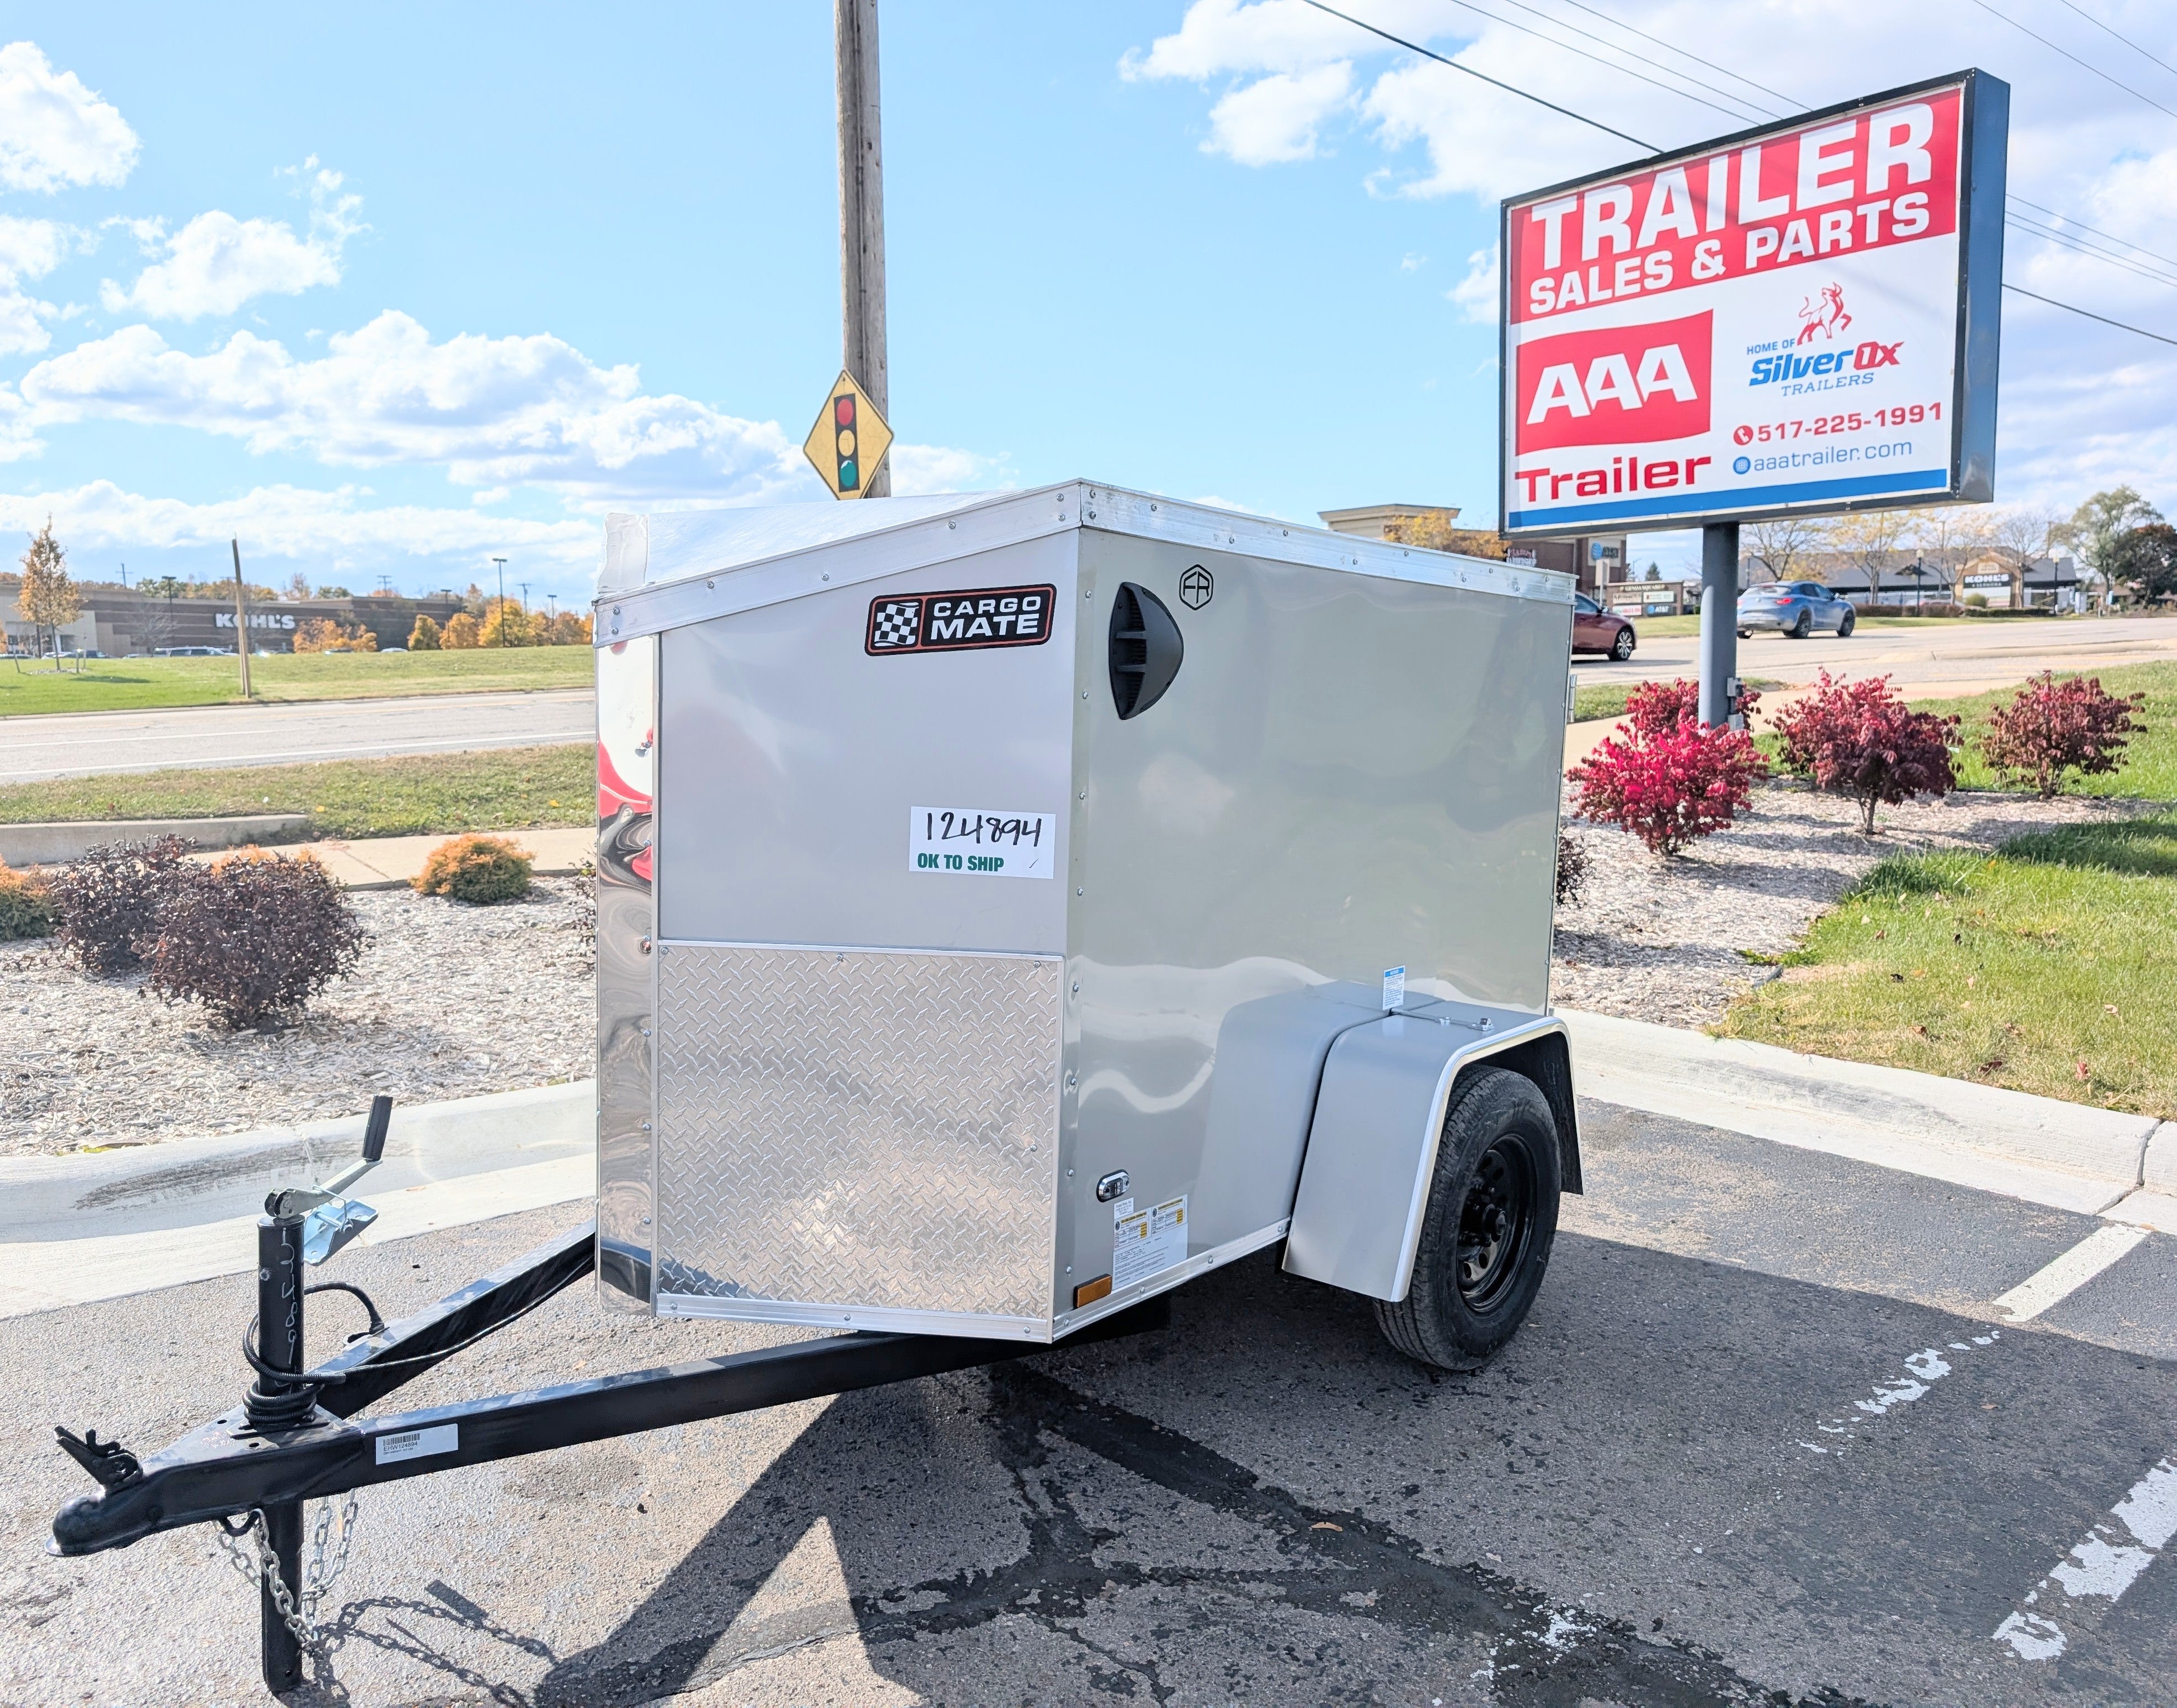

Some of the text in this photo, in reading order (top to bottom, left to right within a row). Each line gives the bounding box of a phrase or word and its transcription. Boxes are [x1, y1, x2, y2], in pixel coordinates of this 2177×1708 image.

[1531, 102, 1934, 271] TRAILER
[1530, 191, 1930, 314] SALES & PARTS
[1747, 339, 1795, 355] HOME OF
[1526, 344, 1698, 425] AAA
[1781, 373, 1874, 396] TRAILERS
[1758, 401, 1941, 442] 517-225-1991
[1754, 441, 1912, 471] aaatrailer.com
[1515, 456, 1712, 503] Trailer
[1965, 574, 2010, 583] KOHL'S
[934, 596, 1041, 617] CARGO
[215, 613, 295, 629] KOHL'S
[930, 613, 1038, 640] MATE
[926, 812, 1042, 847] 124894
[917, 852, 1004, 872] OK TO SHIP
[384, 1441, 418, 1452] EHW124894
